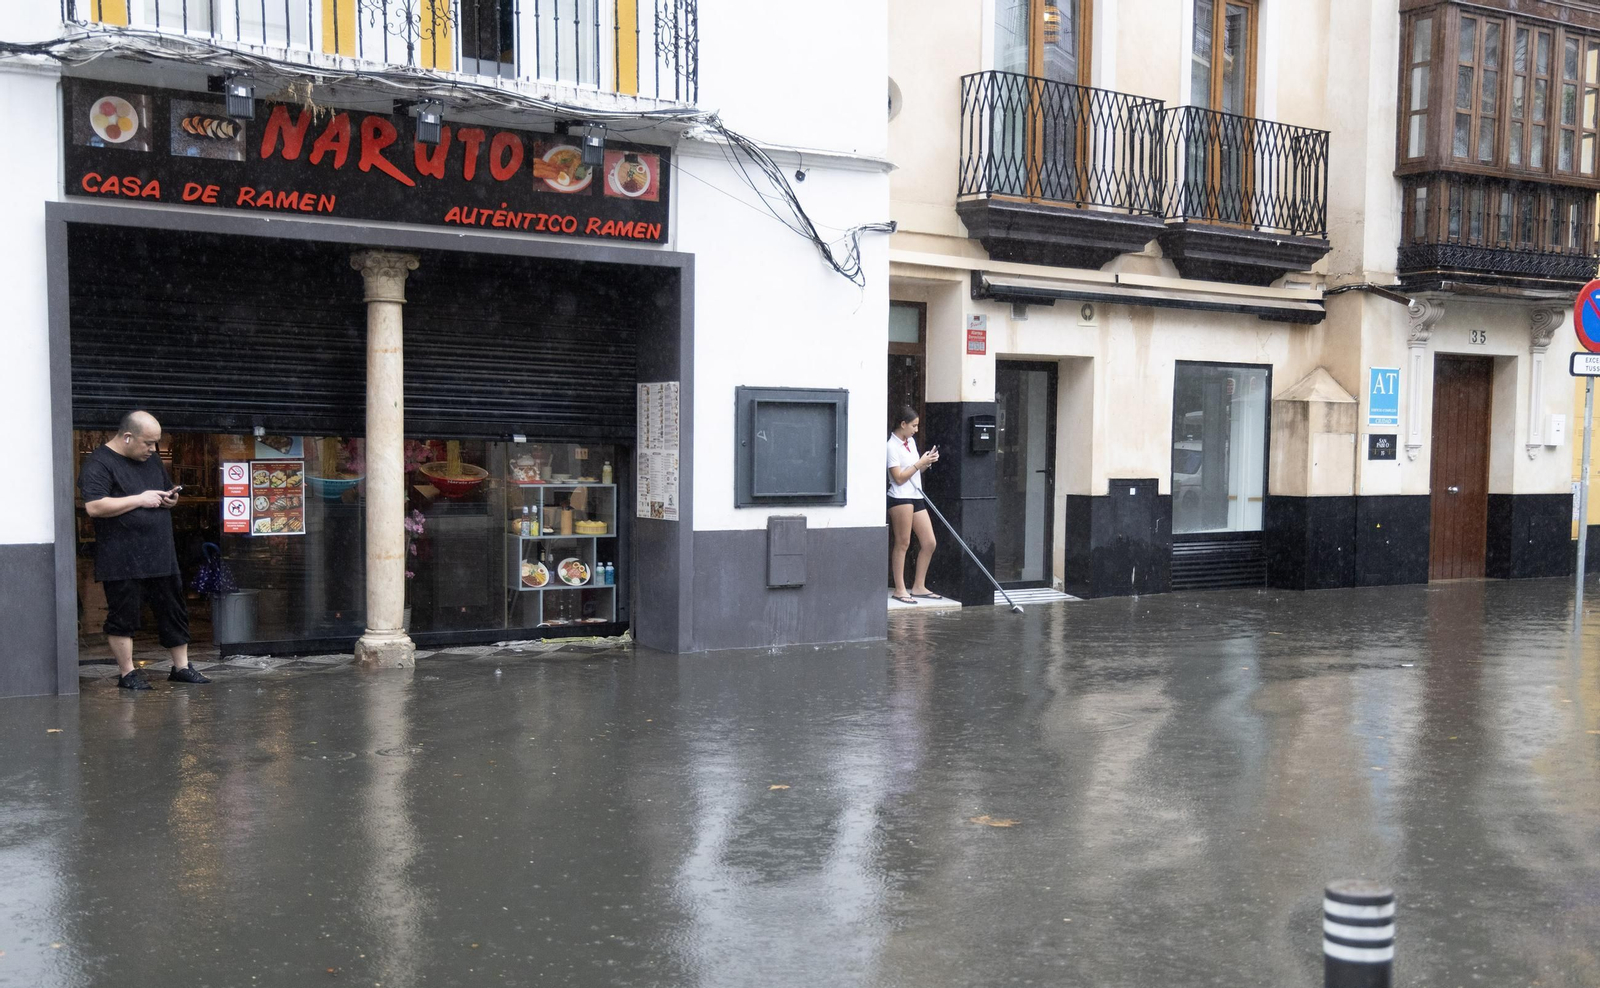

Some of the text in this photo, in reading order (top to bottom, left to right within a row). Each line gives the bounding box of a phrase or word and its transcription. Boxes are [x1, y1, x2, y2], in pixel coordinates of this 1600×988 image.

[260, 104, 524, 187] NARUTO
[81, 172, 336, 213] CASA DE RAMEN
[444, 202, 662, 239] AUTÉNTICO RAMEN
[1471, 329, 1487, 345] 35
[1372, 372, 1398, 395] AT
